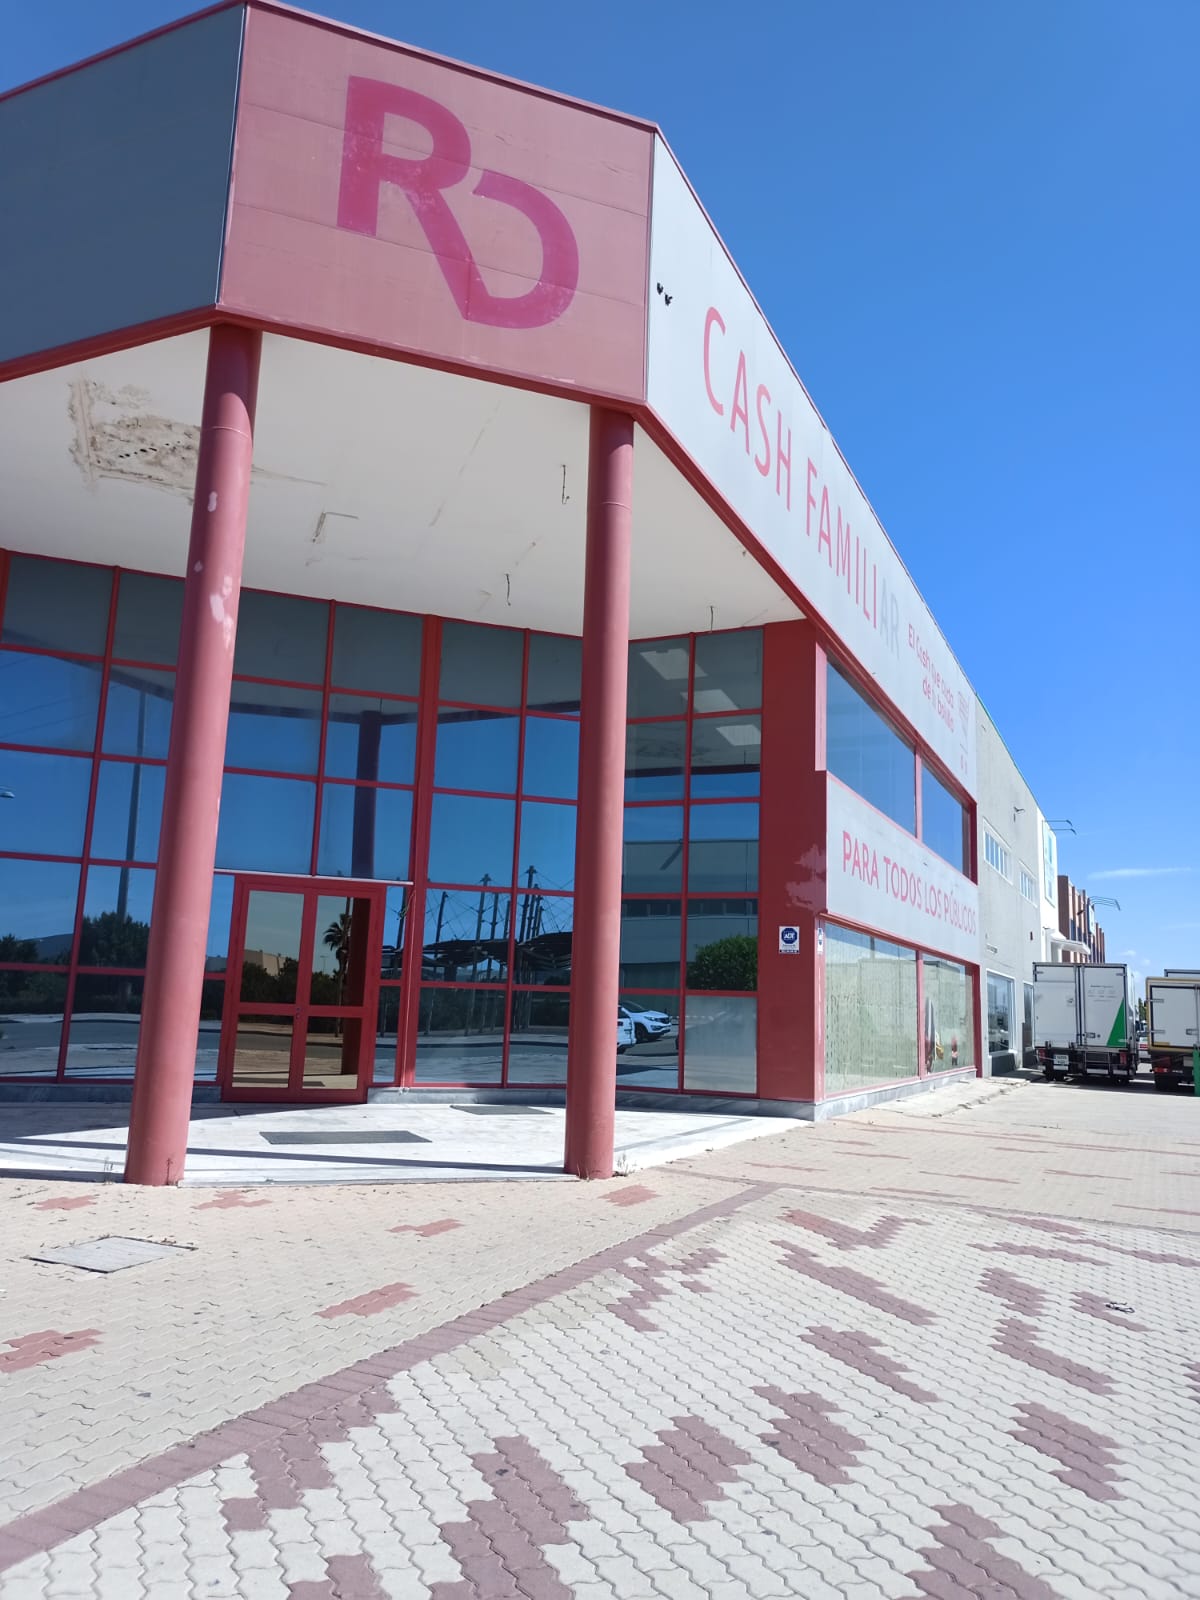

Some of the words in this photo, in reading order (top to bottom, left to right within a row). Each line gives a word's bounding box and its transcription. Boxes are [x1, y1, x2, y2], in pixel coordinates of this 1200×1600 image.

[703, 306, 792, 512] CASH
[805, 457, 901, 661] FAMILIAR
[908, 623, 916, 649] El
[842, 831, 880, 889] PARA
[883, 856, 922, 910] TODOS
[924, 881, 942, 919] LOS
[944, 889, 977, 936] PÚBLICOS
